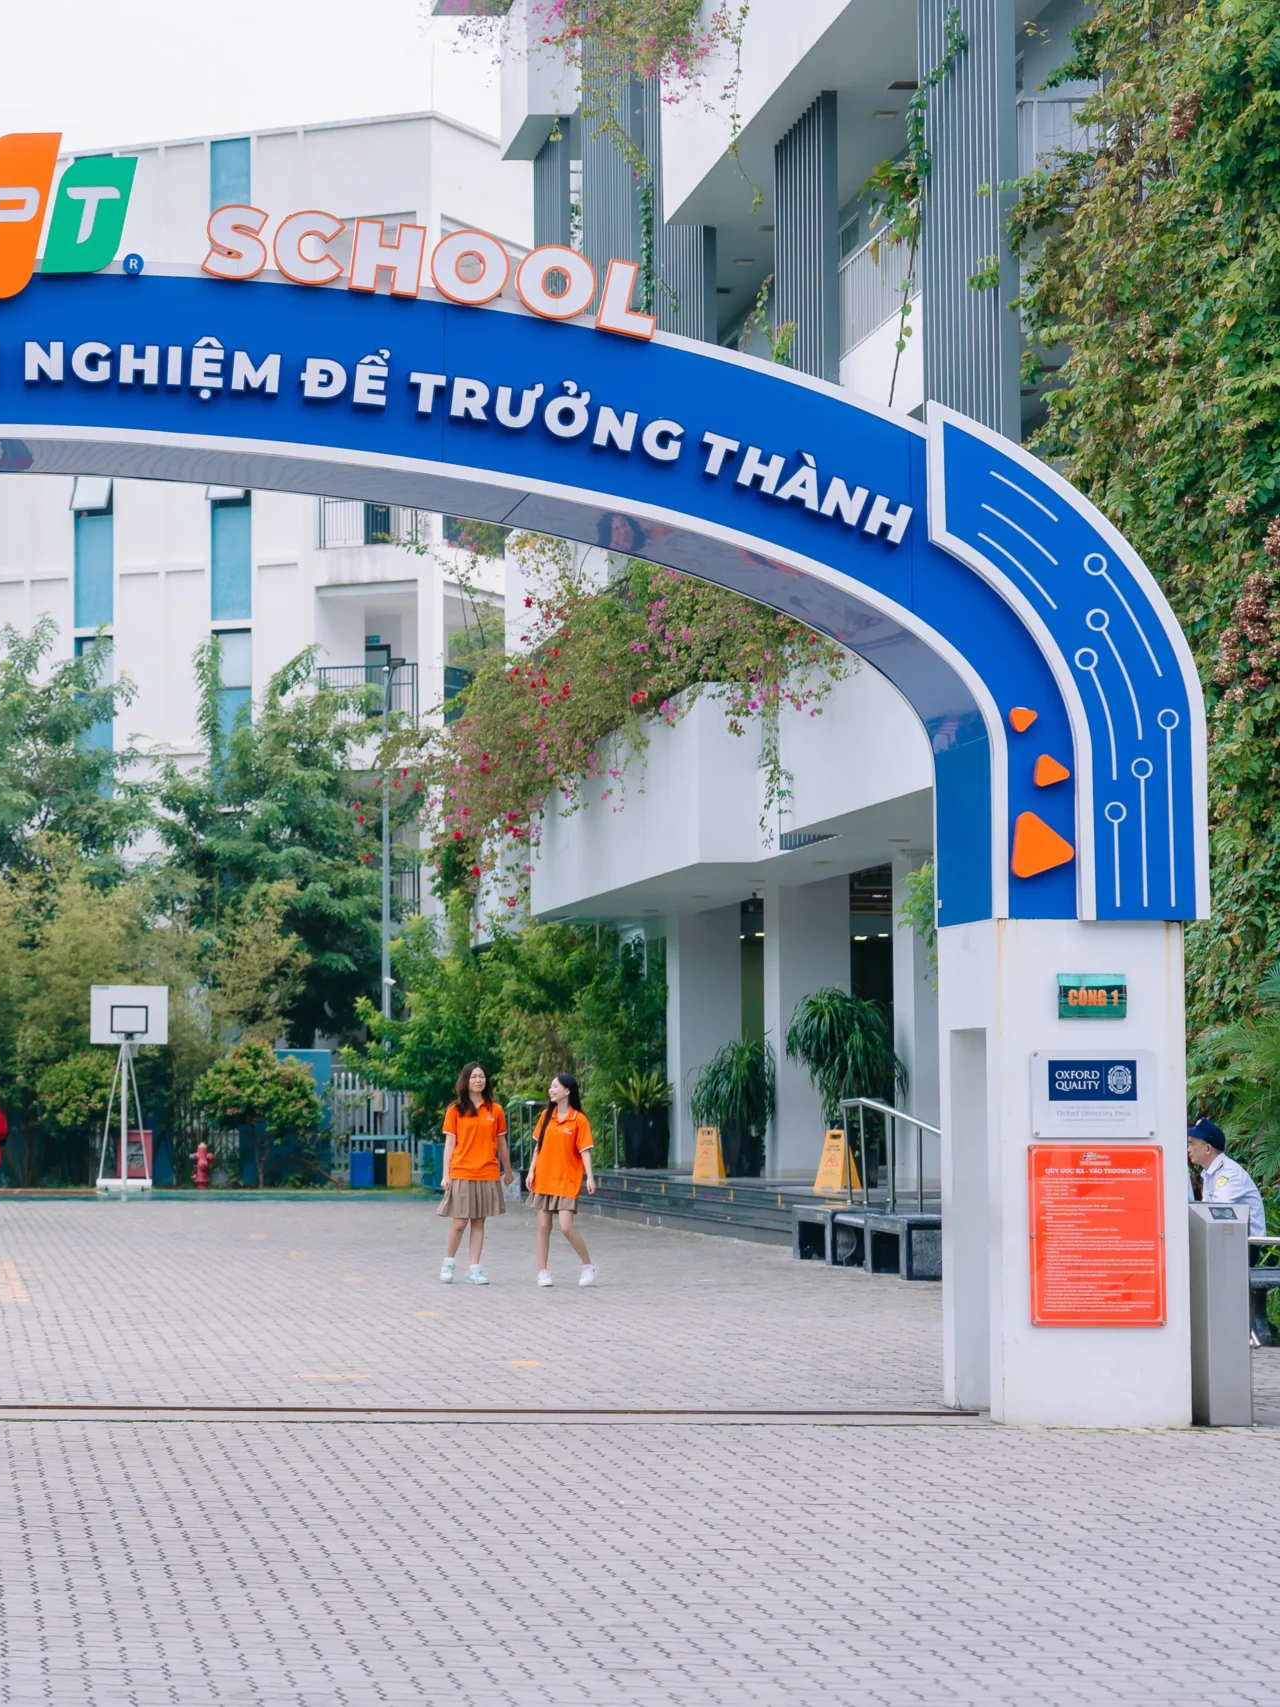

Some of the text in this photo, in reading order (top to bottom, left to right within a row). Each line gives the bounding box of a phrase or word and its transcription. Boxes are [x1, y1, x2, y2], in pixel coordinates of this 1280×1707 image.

[201, 204, 657, 341] SCHOOL
[24, 336, 282, 400] NGHIỆM
[300, 348, 391, 408] ĐỂ
[408, 380, 686, 463] TRƯỞNG
[701, 431, 914, 546] THÀNH
[1111, 989, 1119, 1007] 1
[1055, 1070, 1100, 1080] OXFORD
[1055, 1080, 1101, 1092] QUALITY
